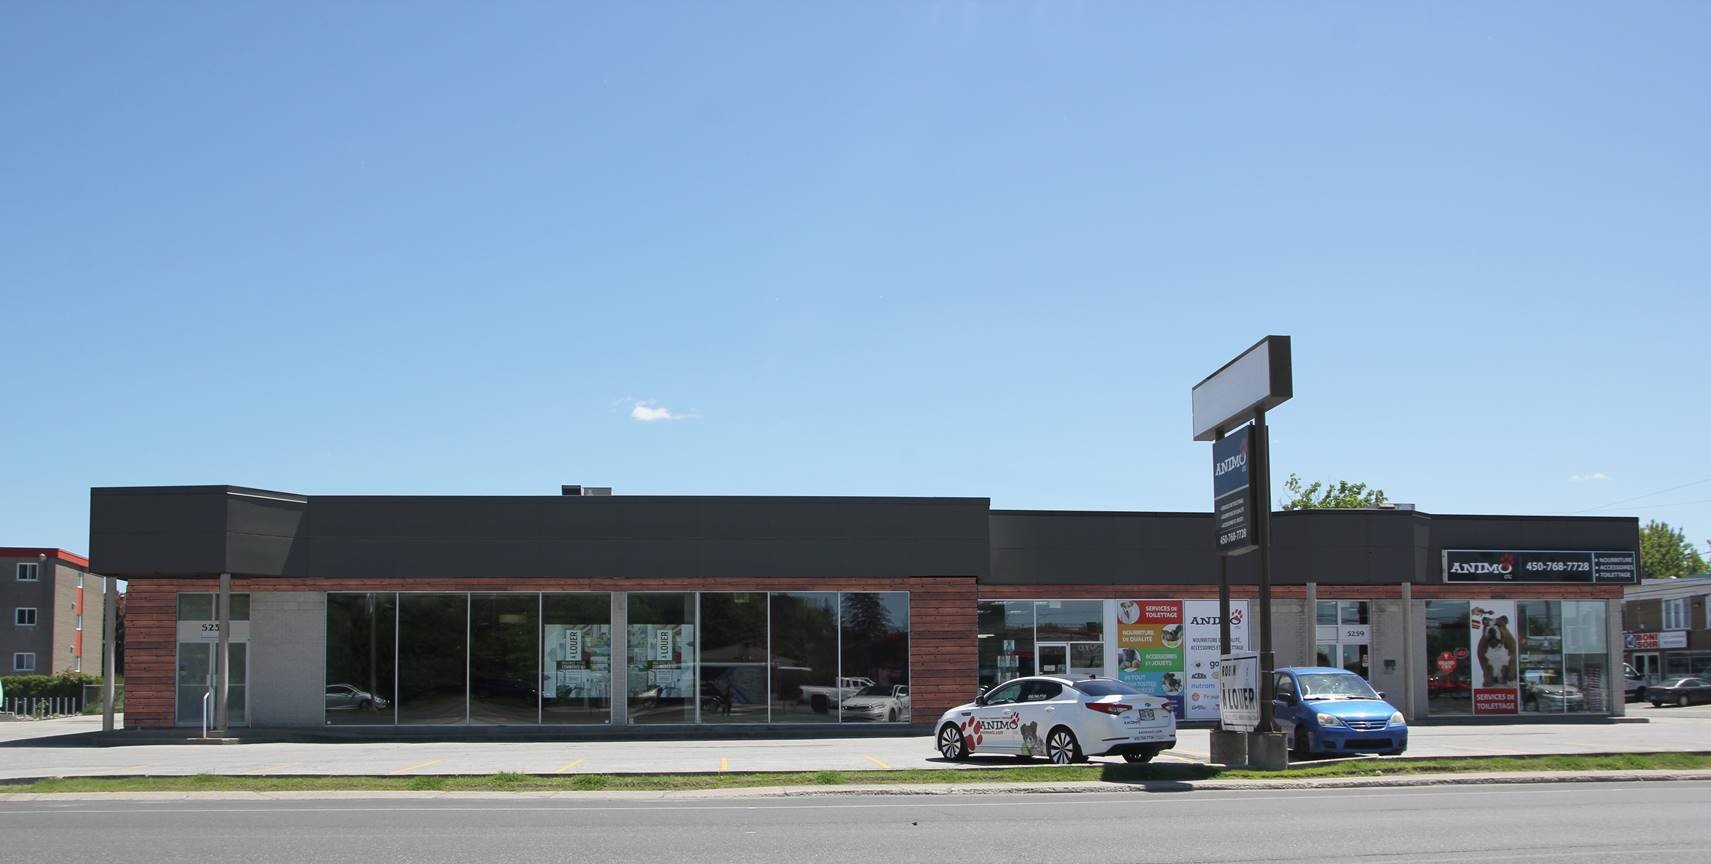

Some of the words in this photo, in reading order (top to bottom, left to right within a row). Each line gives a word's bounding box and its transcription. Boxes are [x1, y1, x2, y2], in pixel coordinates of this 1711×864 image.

[1215, 452, 1247, 476] ANIMO
[1450, 562, 1513, 574] ANIMO
[1526, 562, 1590, 571] 450-768-7728
[1190, 616, 1242, 625] ANIO
[569, 631, 578, 655] LOUER
[660, 631, 669, 655] LOUER
[1228, 687, 1256, 710] LOUER
[1476, 693, 1506, 701] SERVICES
[1477, 702, 1516, 710] TOILETTAGE
[979, 719, 1019, 730] ANIMO
